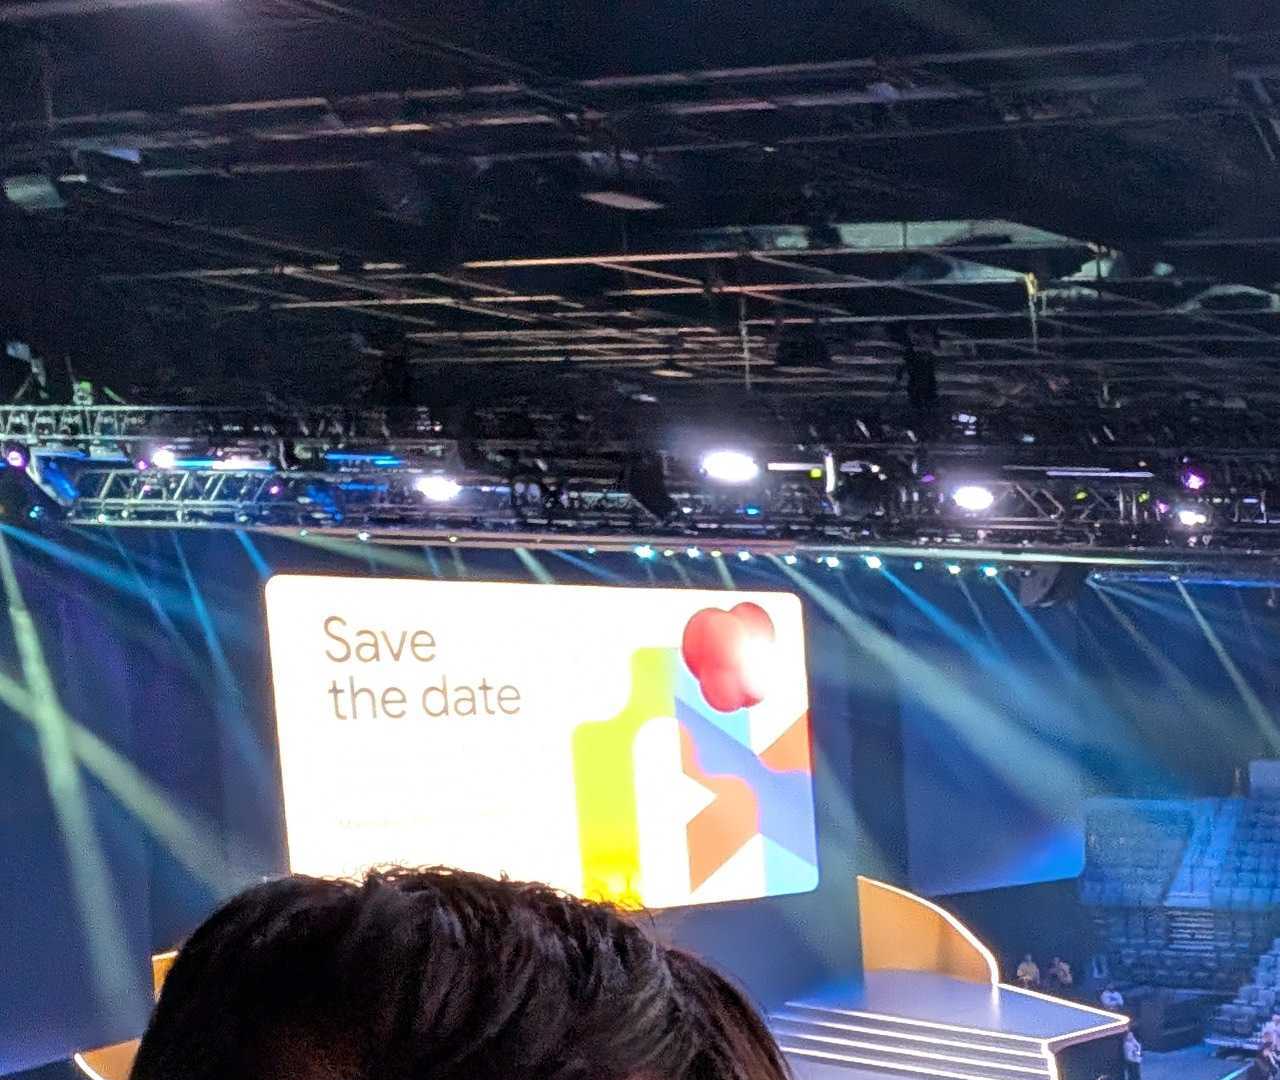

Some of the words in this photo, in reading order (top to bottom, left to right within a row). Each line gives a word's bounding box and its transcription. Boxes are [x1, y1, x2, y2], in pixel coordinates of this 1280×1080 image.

[323, 615, 437, 663] Save
[327, 675, 408, 721] the
[421, 674, 521, 719] date
